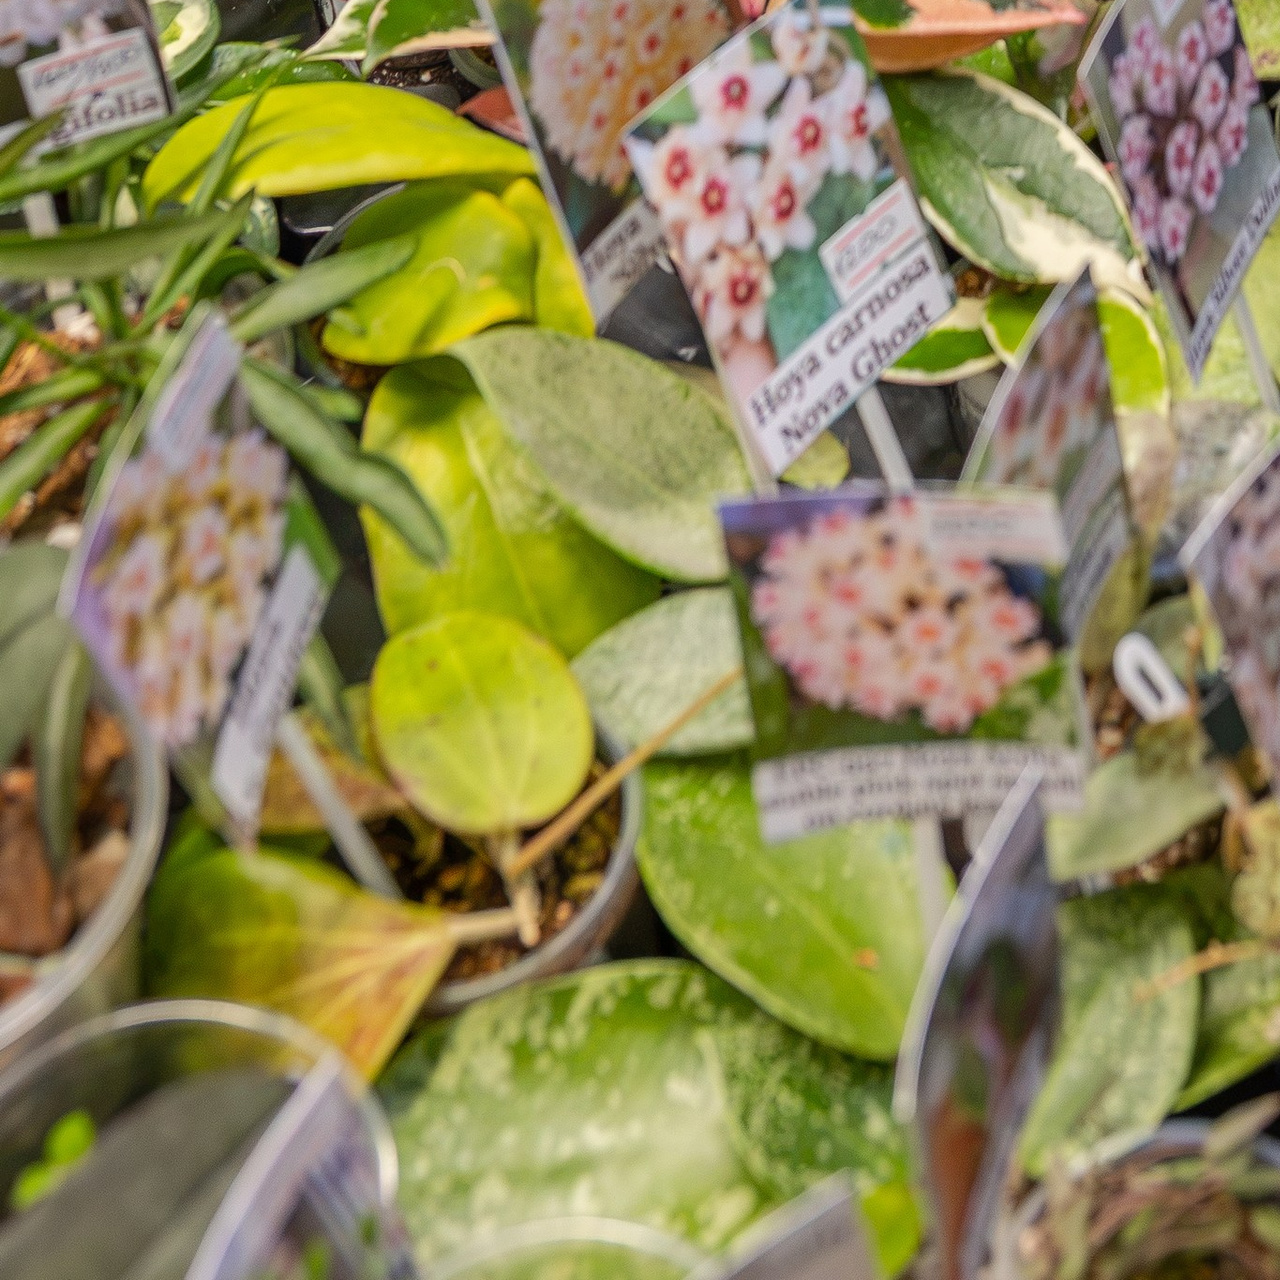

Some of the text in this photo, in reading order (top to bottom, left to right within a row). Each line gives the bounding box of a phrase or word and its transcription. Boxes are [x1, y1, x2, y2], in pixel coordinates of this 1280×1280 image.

[751, 257, 931, 427] Hoya carnosa
[851, 301, 932, 382] Ghost
